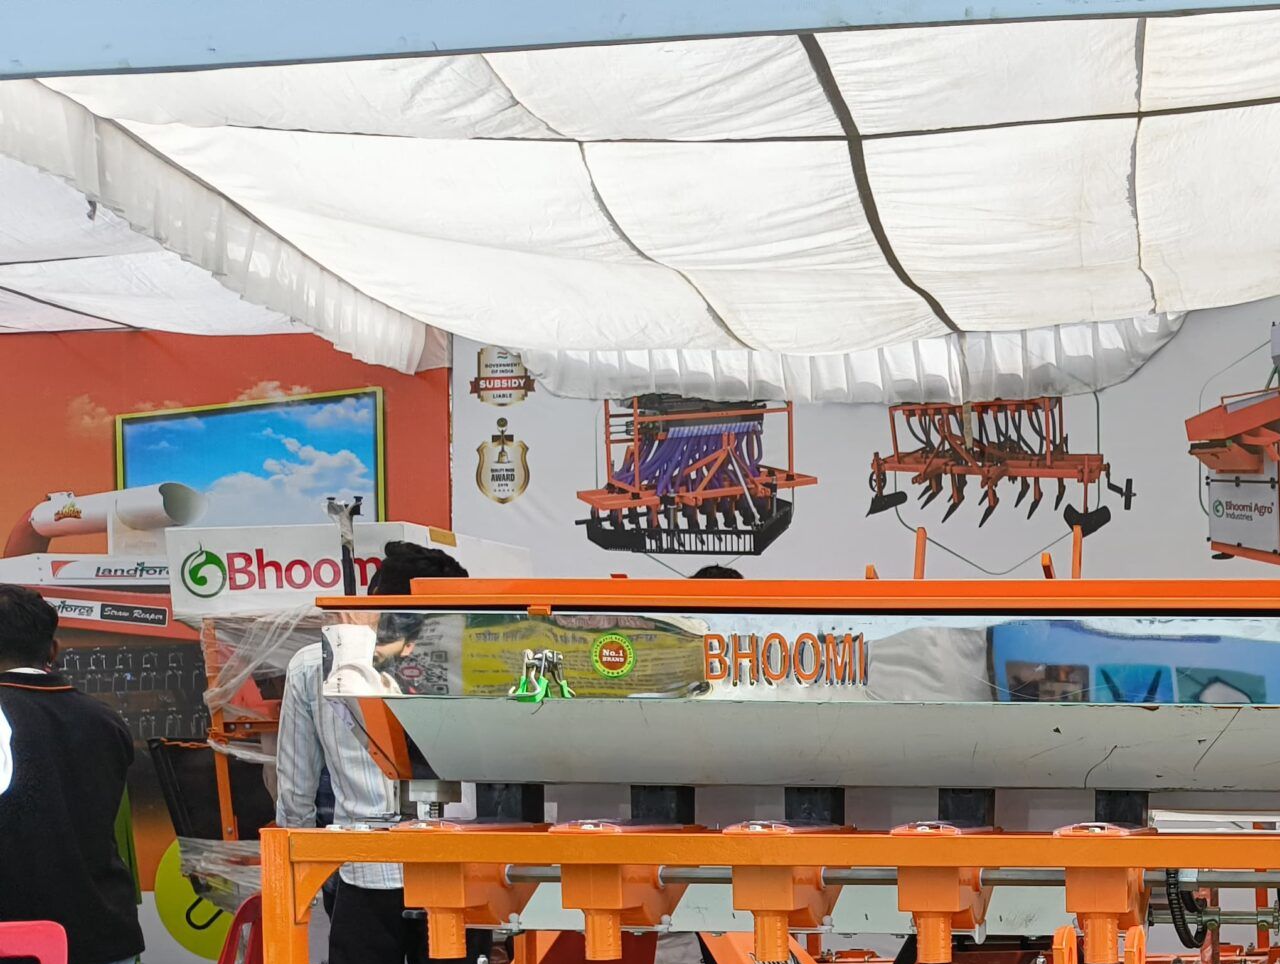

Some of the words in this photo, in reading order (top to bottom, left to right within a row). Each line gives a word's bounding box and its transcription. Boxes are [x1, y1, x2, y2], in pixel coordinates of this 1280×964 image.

[479, 379, 526, 389] SUBSIDY
[490, 473, 515, 482] AWARD
[1225, 501, 1253, 513] Bhoomi
[1253, 503, 1273, 517] Agro
[602, 648, 625, 657] No.1
[703, 632, 865, 681] BHOOMI
